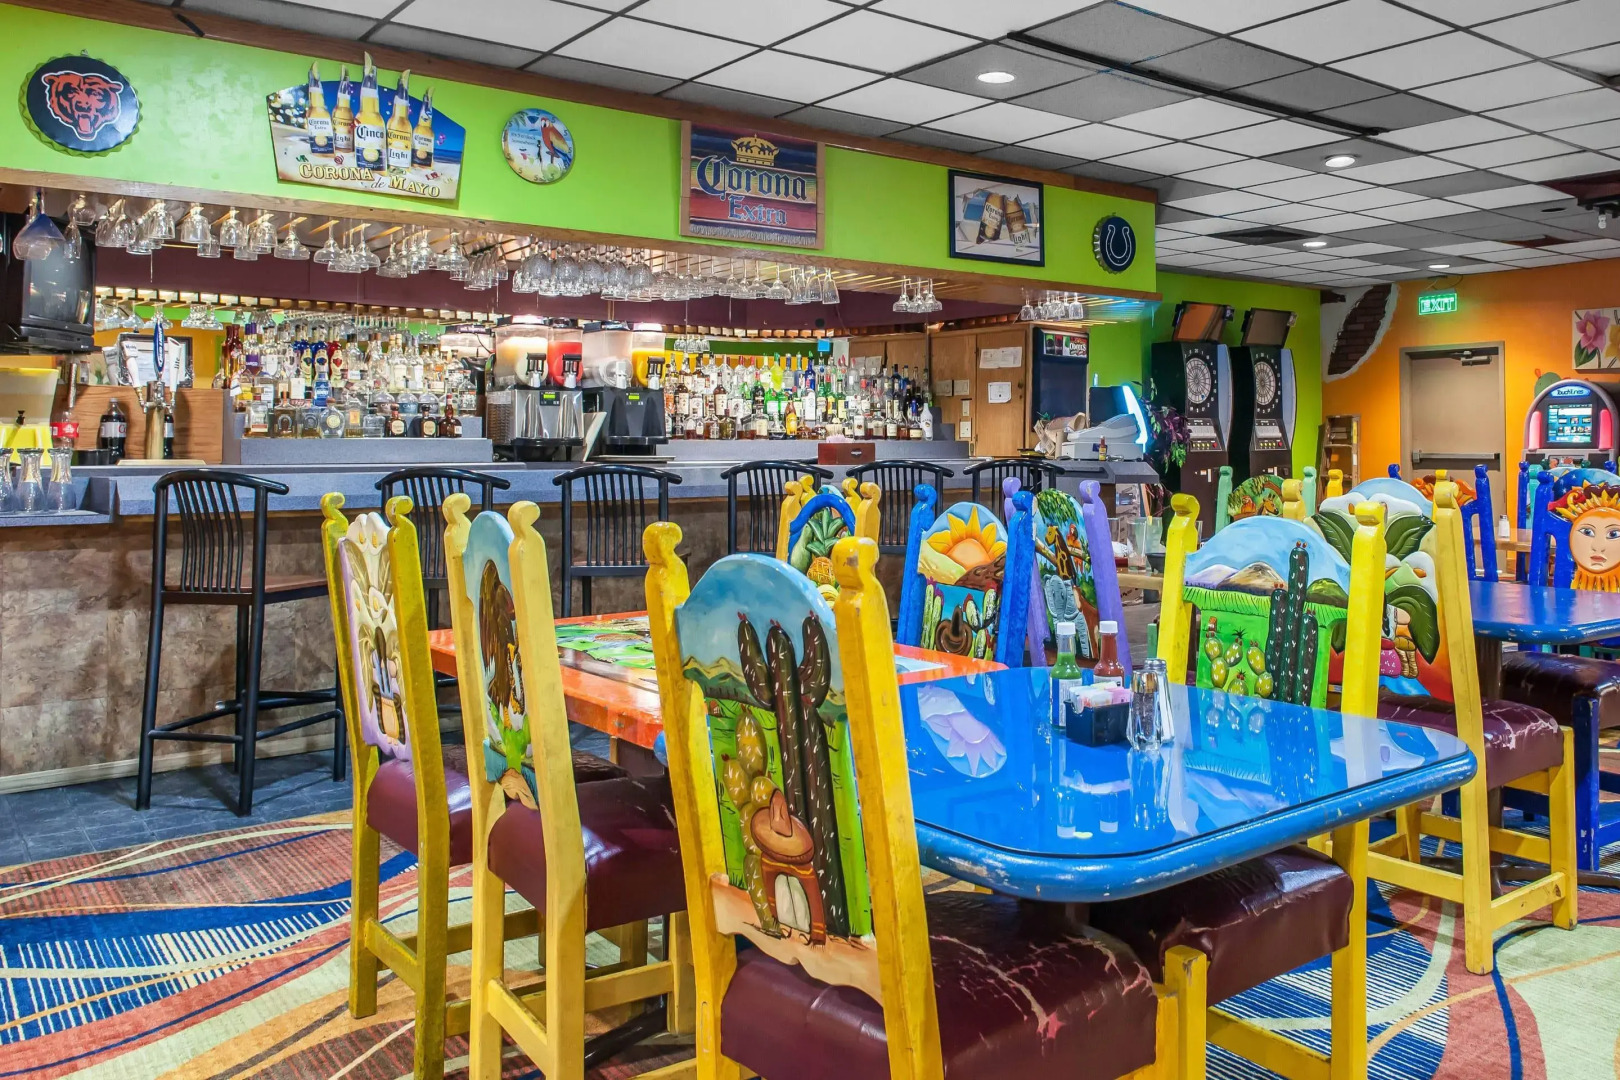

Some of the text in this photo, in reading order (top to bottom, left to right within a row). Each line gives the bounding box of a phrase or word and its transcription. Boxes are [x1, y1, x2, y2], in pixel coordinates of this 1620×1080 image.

[356, 125, 384, 141] Cinco
[389, 149, 408, 159] Light
[300, 162, 440, 198] CORONA de MAYO
[696, 155, 807, 201] Corona
[728, 194, 787, 226] Extra
[1421, 297, 1454, 312] EXIT
